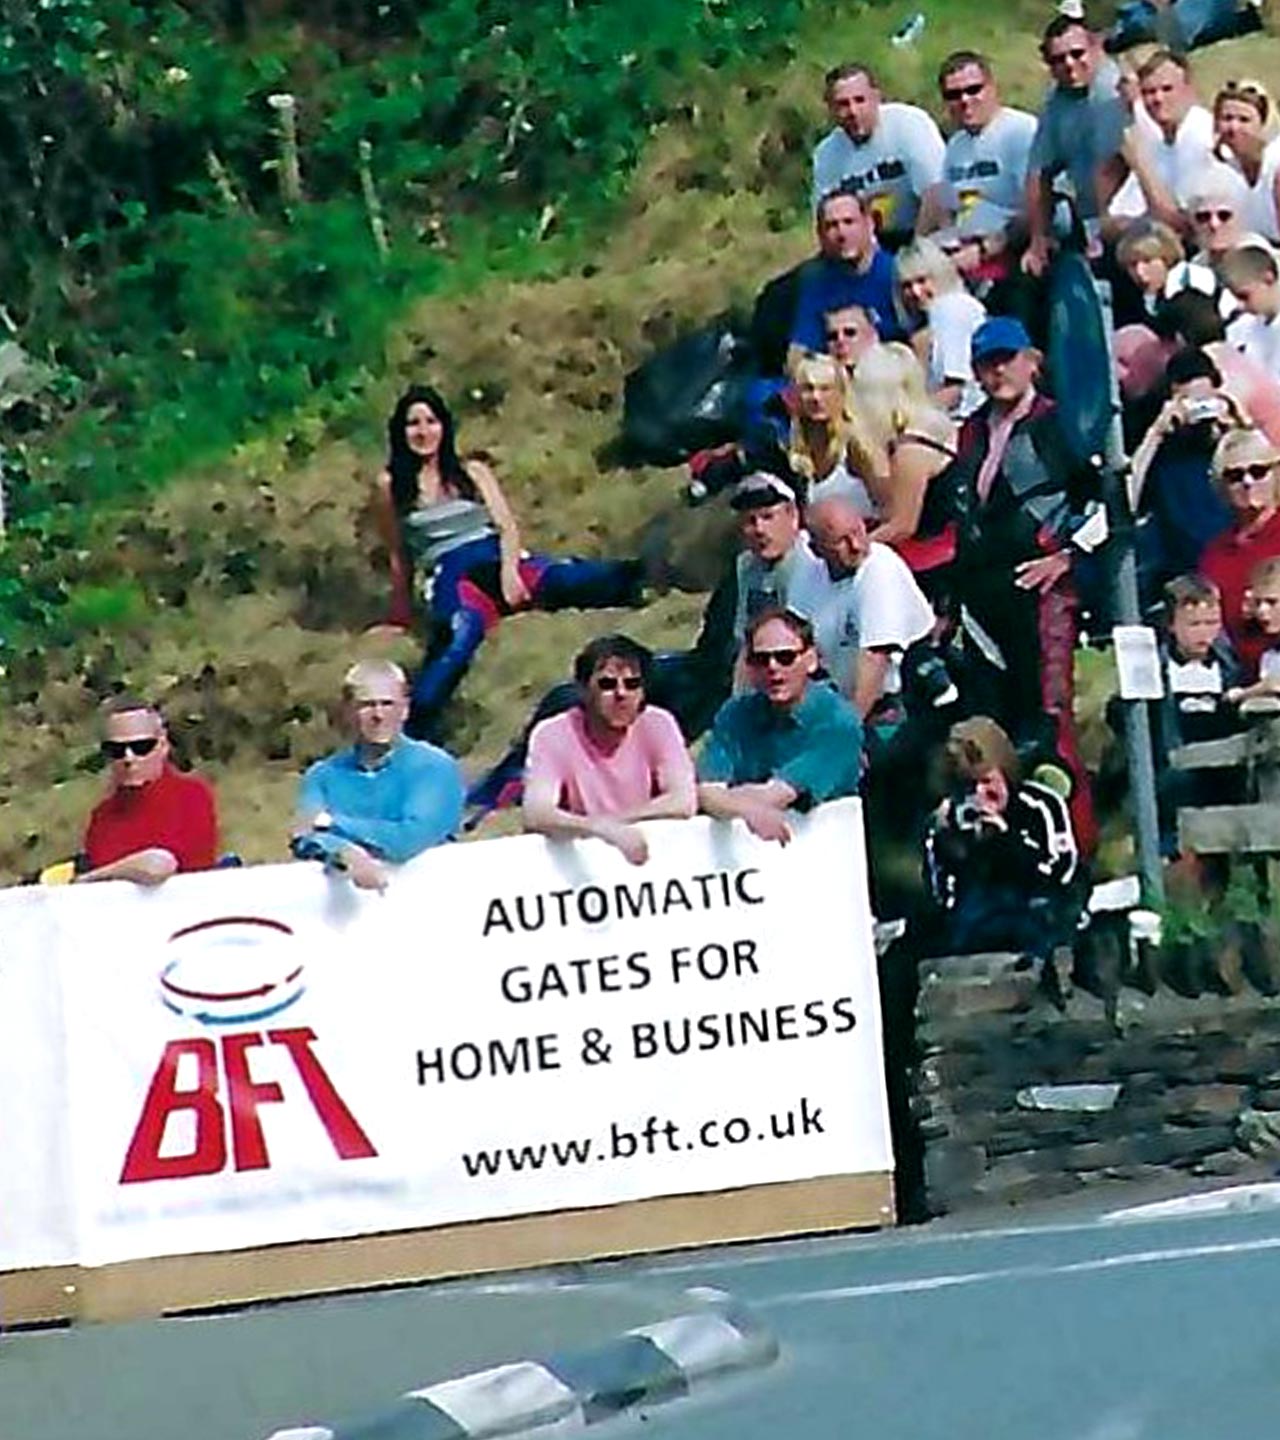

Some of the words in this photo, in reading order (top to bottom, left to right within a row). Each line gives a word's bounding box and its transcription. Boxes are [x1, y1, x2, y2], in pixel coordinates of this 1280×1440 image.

[482, 867, 766, 938] AUTOMATIC
[500, 950, 652, 1005] GATES
[670, 938, 760, 984] FOR
[415, 1032, 562, 1087] HOME
[580, 1026, 613, 1067] &
[631, 996, 858, 1060] BUSINESS
[118, 1026, 379, 1185] BFT
[461, 1097, 826, 1178] www.bft.co.uk
